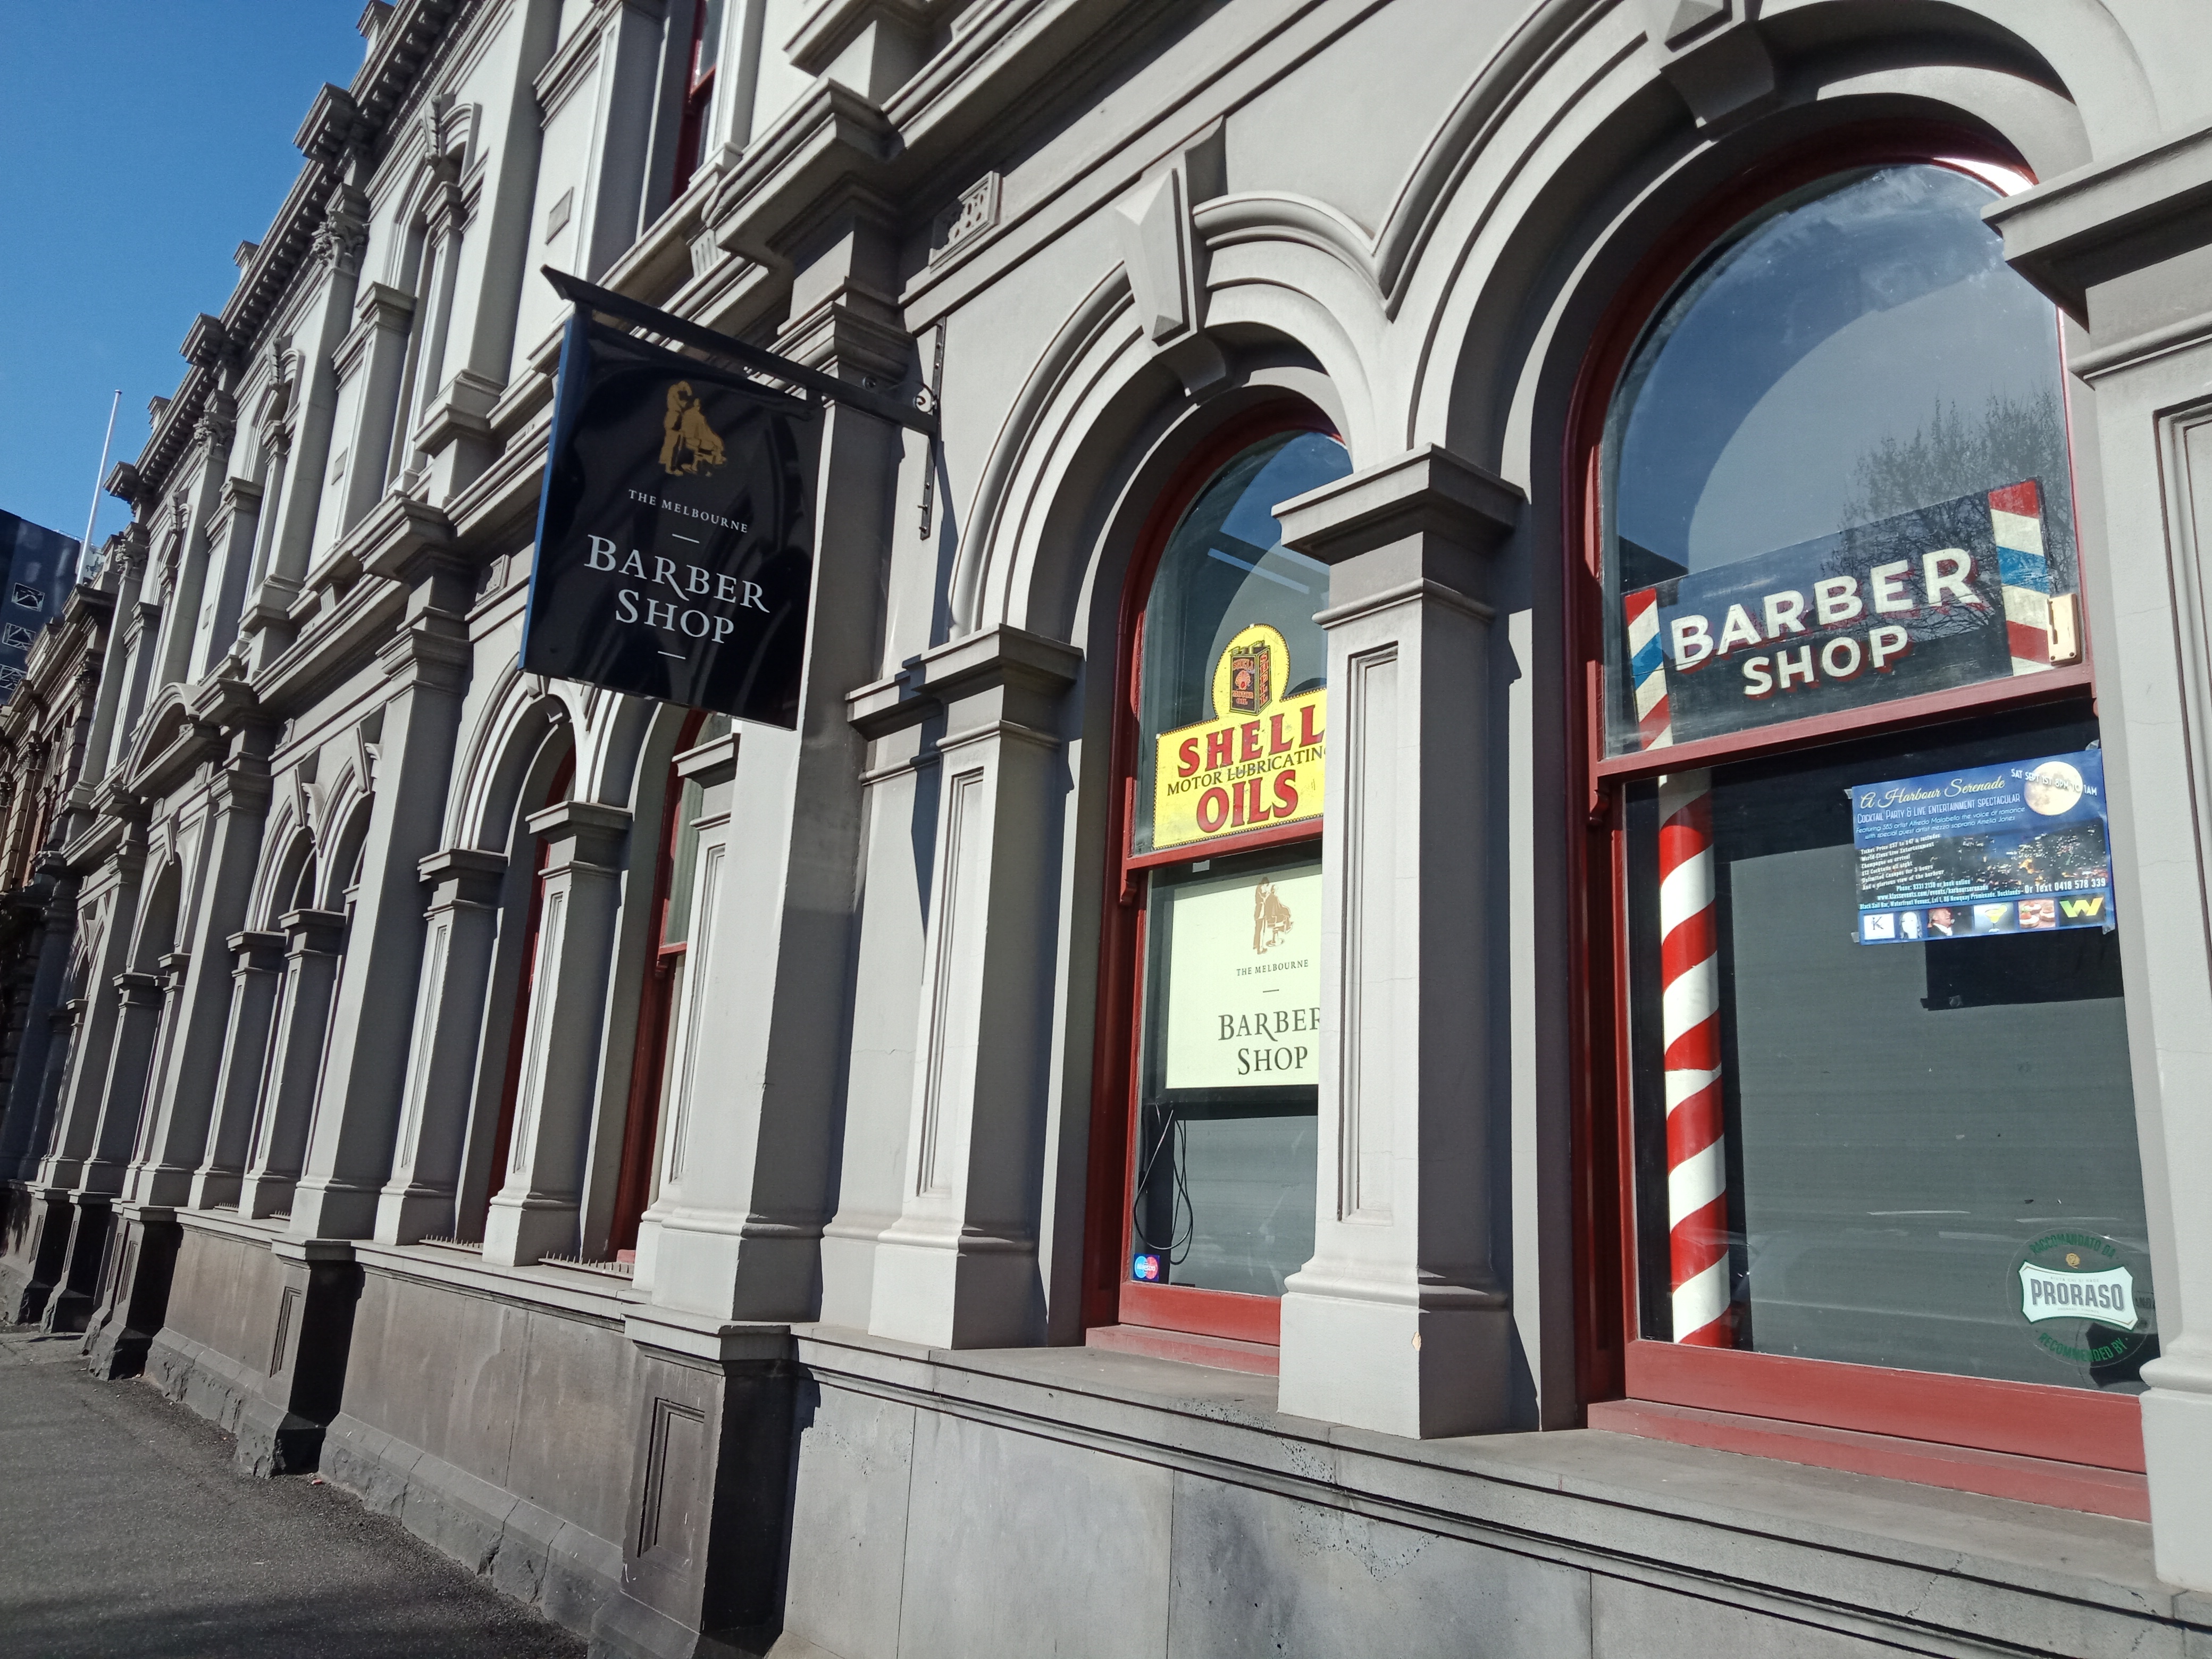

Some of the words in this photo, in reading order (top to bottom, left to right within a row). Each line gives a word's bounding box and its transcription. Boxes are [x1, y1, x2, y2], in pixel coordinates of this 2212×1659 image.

[629, 489, 657, 507] THE
[661, 498, 748, 533] MELBOURNE
[583, 534, 770, 613] BARBER
[615, 589, 734, 644] SHOP
[1670, 548, 1988, 673] BARBER
[1743, 625, 1910, 698] SHOP
[1233, 690, 1254, 699] MOTOR
[1177, 705, 1325, 778] SHELL
[1167, 770, 1222, 796] MOTOR
[1227, 745, 1326, 782] LUBRICATIN
[2011, 768, 2023, 779] SAT
[2025, 772, 2039, 782] SEPT
[2041, 775, 2052, 785] 1ST
[2055, 778, 2069, 789] 8PM
[2071, 783, 2081, 792] TO
[2084, 784, 2097, 796] 1AM
[1196, 769, 1298, 833] OILS
[1861, 792, 1876, 809] A
[1878, 787, 1941, 808] Harbour
[1944, 775, 2005, 798] Serenade
[1907, 807, 1912, 817] &
[1928, 799, 1975, 814] ENTERTAINMENT
[1978, 793, 2020, 808] SPECTACULAR
[1856, 825, 1881, 834] Featuring
[1951, 820, 1975, 829] soprano
[2025, 884, 2033, 894] Or
[2035, 883, 2052, 893] Text
[2054, 881, 2072, 891] 0418
[2075, 879, 2089, 889] 578
[2091, 877, 2106, 887] 339
[1236, 966, 1252, 977] THE
[1254, 959, 1309, 974] MELBOURNE
[1237, 1046, 1309, 1076] SHOP
[2030, 1278, 2126, 1312] PRORASO
[2039, 1332, 2113, 1363] RECOMMENDED
[2111, 1337, 2128, 1354] BY
